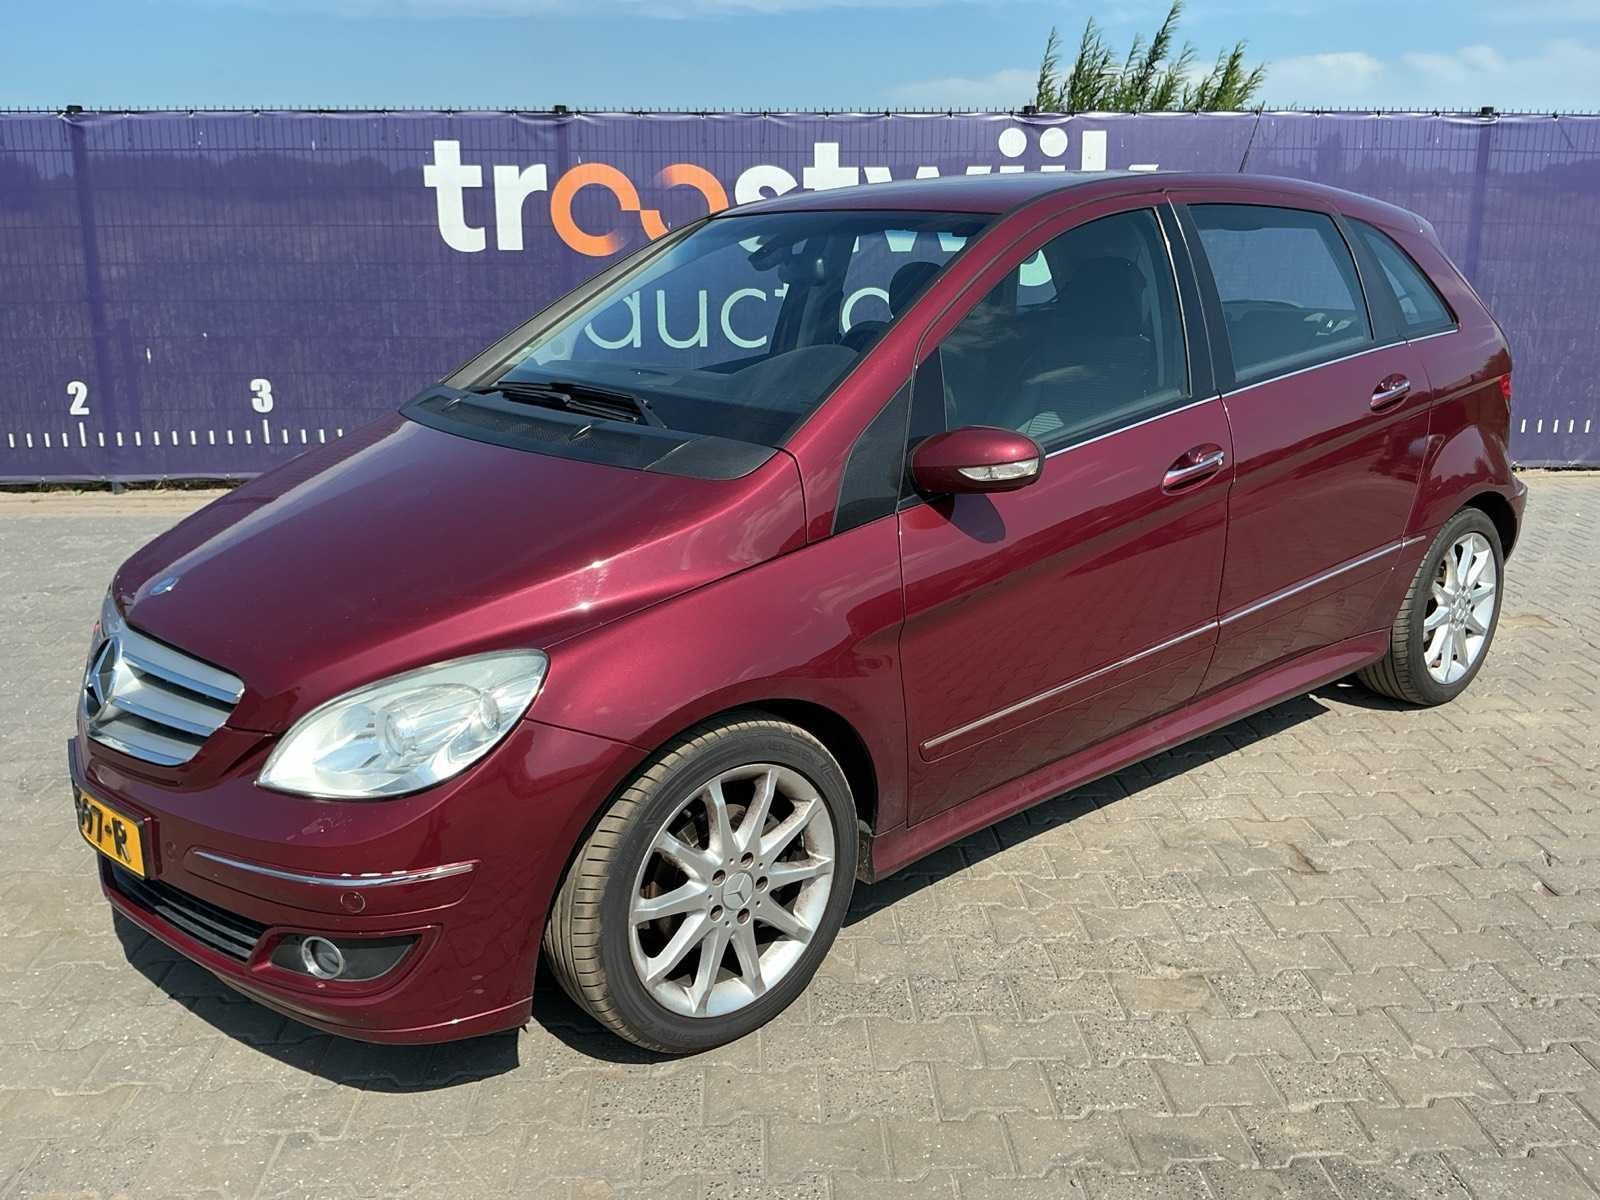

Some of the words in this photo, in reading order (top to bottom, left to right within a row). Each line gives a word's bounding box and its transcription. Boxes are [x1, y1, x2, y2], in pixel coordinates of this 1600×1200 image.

[423, 127, 1159, 287] troost
[66, 380, 90, 416] 2
[250, 378, 274, 413] 3
